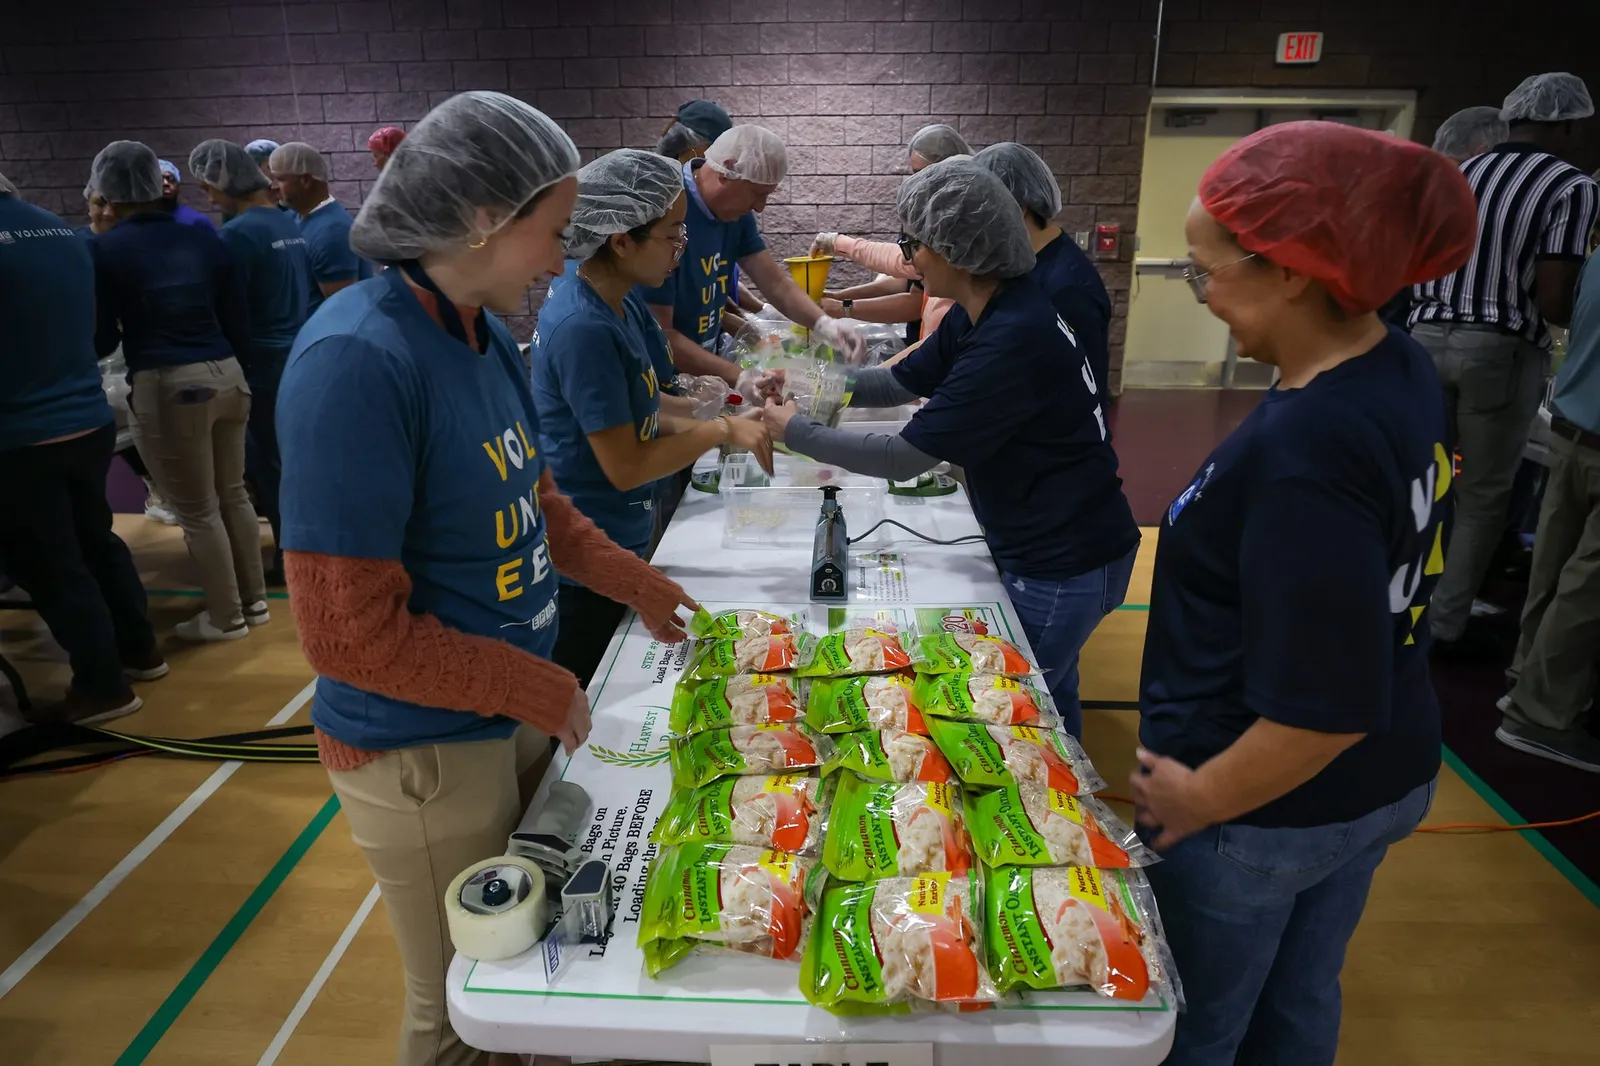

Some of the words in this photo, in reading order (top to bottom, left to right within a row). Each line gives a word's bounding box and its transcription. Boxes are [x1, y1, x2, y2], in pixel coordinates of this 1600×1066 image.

[1285, 34, 1319, 60] EXIT
[641, 651, 655, 669] STEP
[652, 667, 667, 684] Load
[659, 649, 674, 665] Bags
[629, 711, 658, 753] HARVEST
[580, 824, 602, 853] Bags
[595, 807, 608, 821] on
[601, 806, 628, 850] Picture.
[626, 789, 653, 838] BEFORE
[616, 842, 639, 872] Bags
[871, 817, 893, 872] INSTANT
[992, 815, 1027, 857] Cinnamon
[1007, 813, 1042, 859] INSTANT
[612, 876, 627, 893] 40
[682, 868, 696, 921] Cinnamon
[694, 871, 712, 925] INSTANT
[1075, 867, 1088, 893] Nutrie
[1085, 866, 1099, 896] Enriche
[832, 927, 859, 990] Cinnamon
[849, 932, 878, 993] INSTANT
[998, 911, 1028, 974] Cinnamon
[1012, 913, 1048, 978] INSTANT
